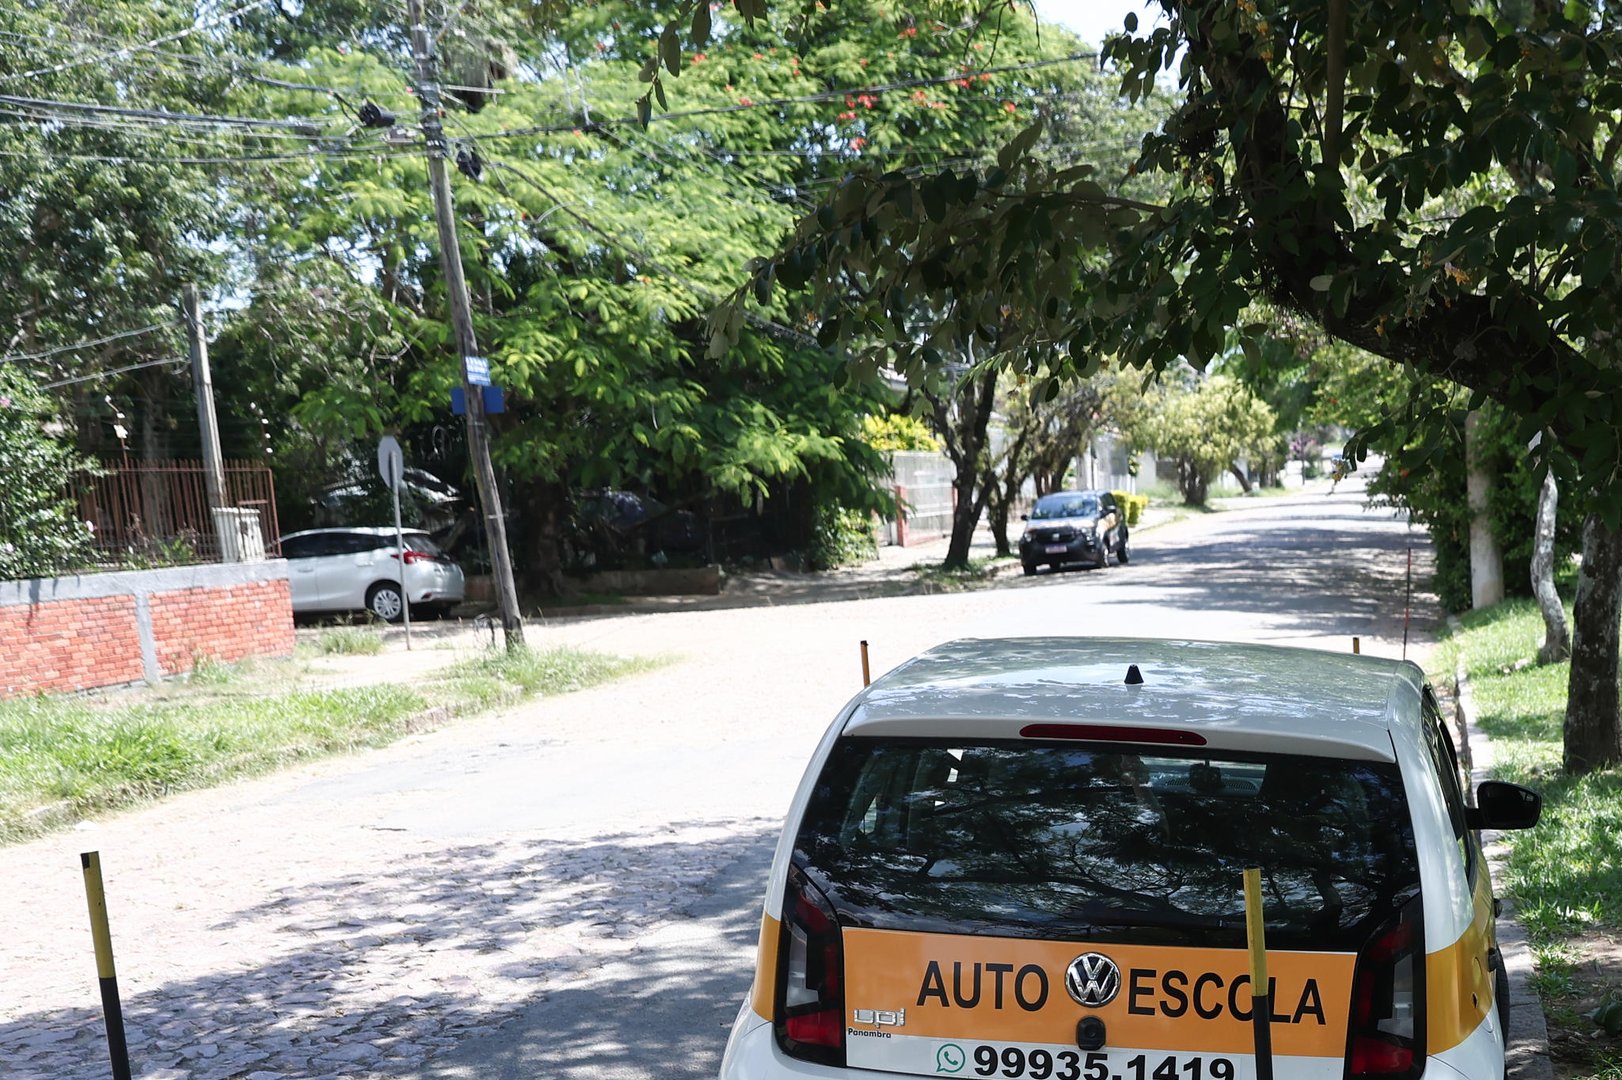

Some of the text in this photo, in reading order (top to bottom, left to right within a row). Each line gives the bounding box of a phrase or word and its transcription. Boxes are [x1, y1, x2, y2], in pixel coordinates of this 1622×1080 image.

[916, 960, 1327, 1025] AUTO ESCOLA
[847, 1027, 892, 1039] Panambra
